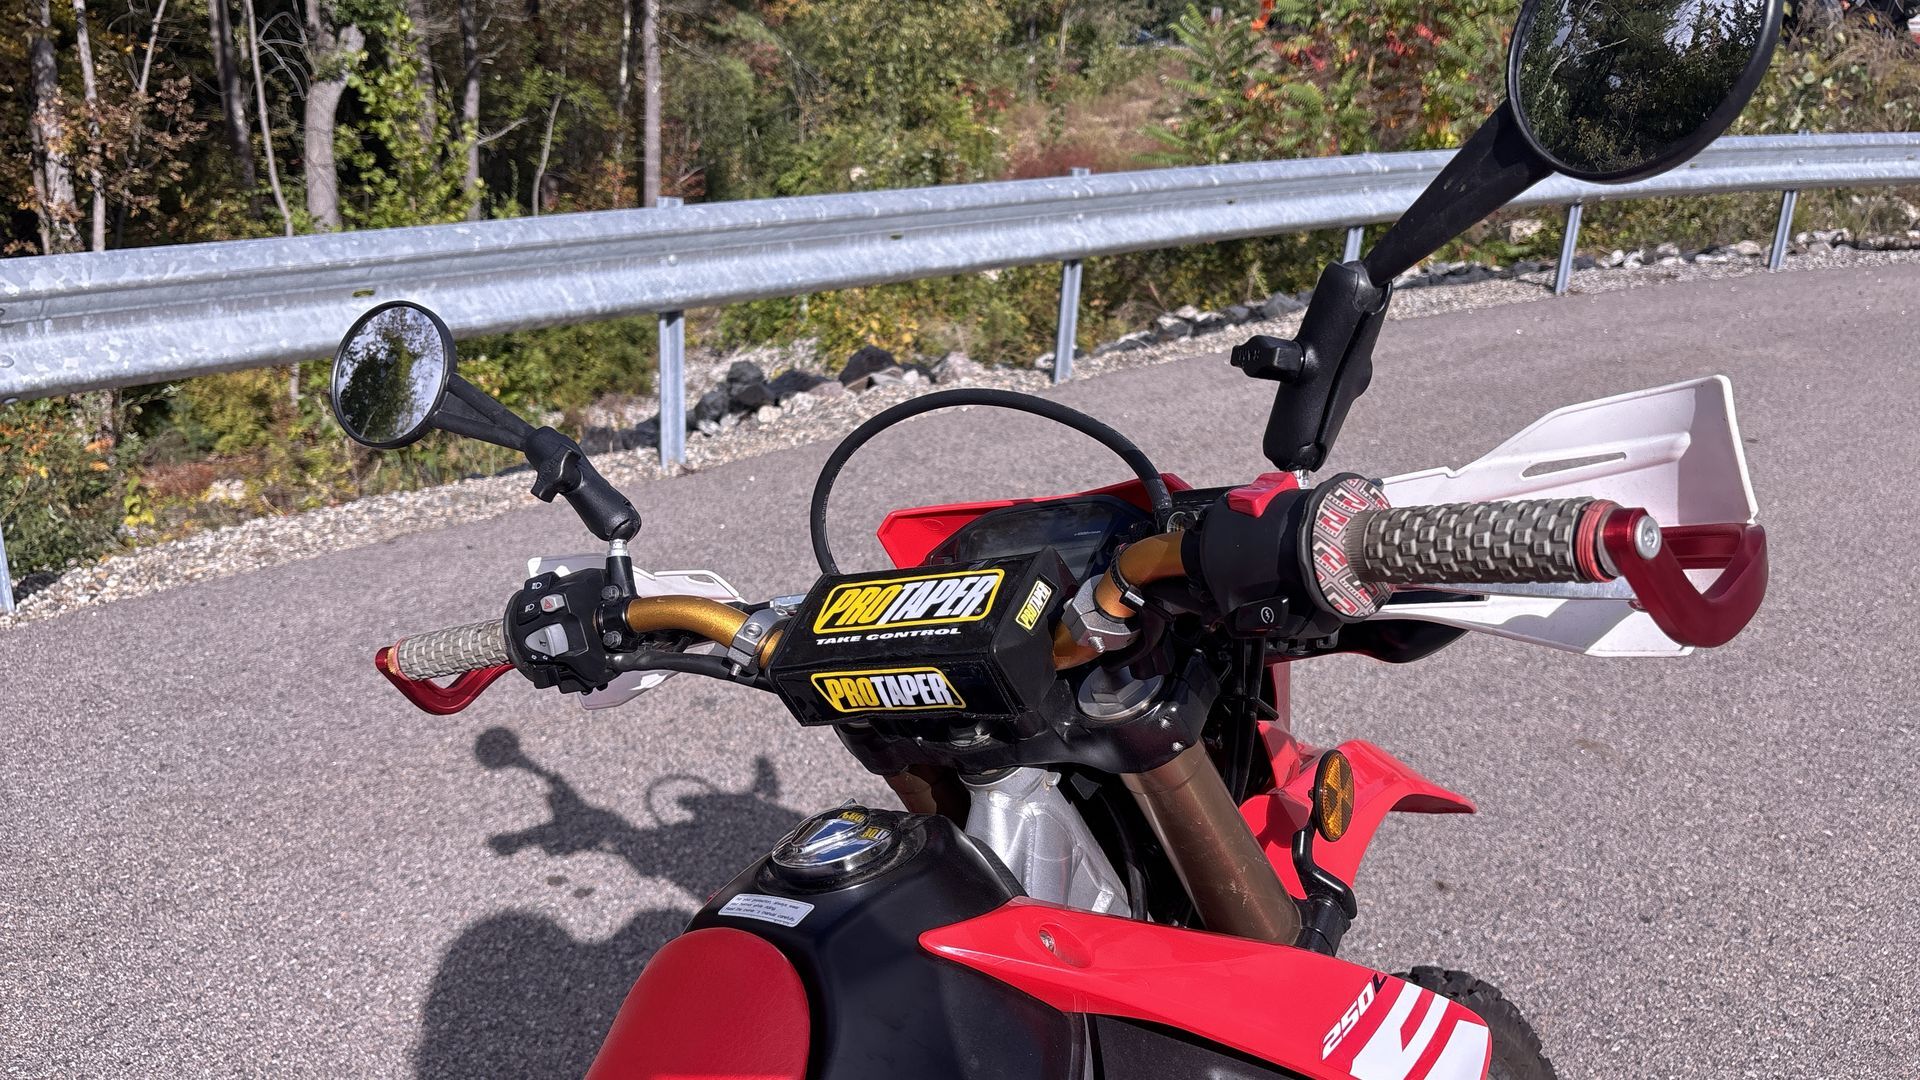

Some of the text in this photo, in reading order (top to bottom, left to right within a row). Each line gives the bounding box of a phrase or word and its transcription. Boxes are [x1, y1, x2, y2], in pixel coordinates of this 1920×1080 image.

[823, 574, 999, 626] PROTAPER
[1019, 582, 1050, 628] PROTAPER
[816, 627, 962, 645] TAKE CONTROL
[823, 673, 954, 709] PROTAPER
